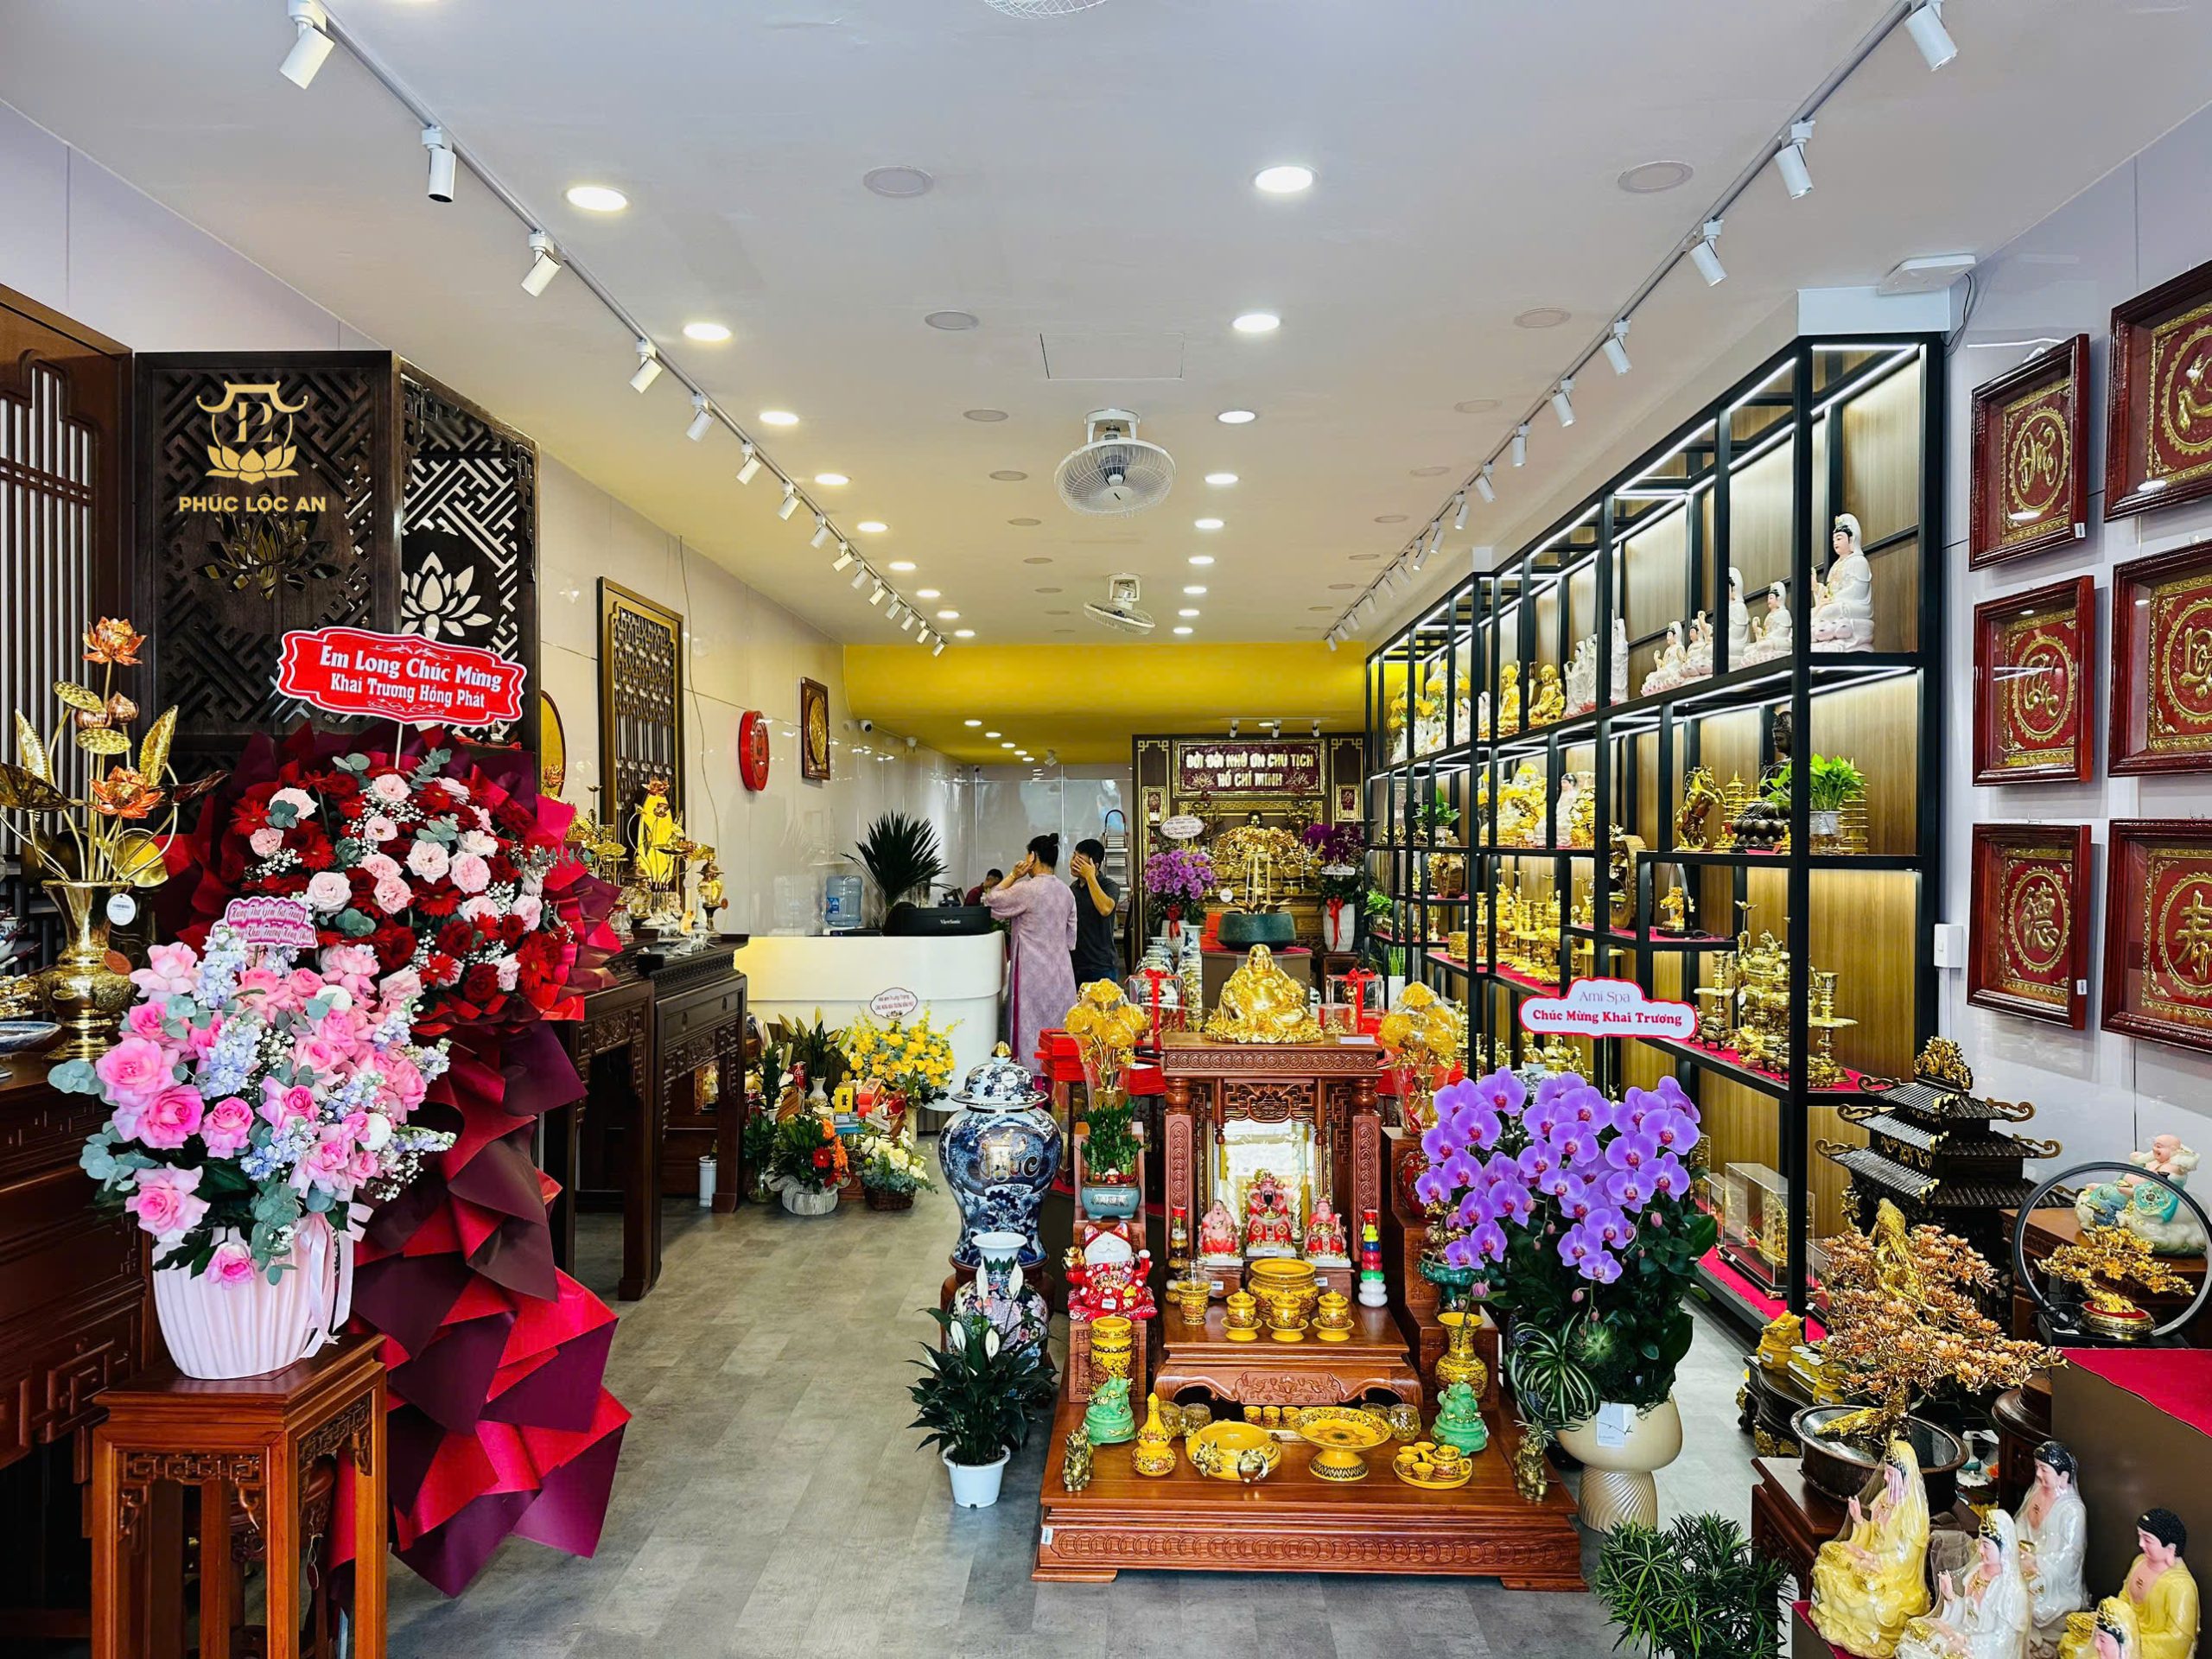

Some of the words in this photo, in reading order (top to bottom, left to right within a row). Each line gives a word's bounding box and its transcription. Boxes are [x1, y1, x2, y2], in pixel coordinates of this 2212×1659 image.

[179, 493, 239, 512] PHÚC
[245, 493, 289, 515] LỘC
[295, 496, 326, 512] AN
[319, 645, 349, 669] Em
[354, 650, 401, 679] Long
[406, 658, 450, 683] Chúc
[454, 664, 503, 692] Mừng
[330, 672, 363, 694] Khai
[366, 679, 416, 703] Trương
[420, 684, 453, 709] Hồng
[456, 690, 486, 709] Phát
[1268, 749, 1287, 768] CHỦ
[1291, 753, 1313, 770] TỊCH
[1234, 770, 1252, 787] CHÍ
[1255, 772, 1283, 787] MINH
[2018, 881, 2060, 953] 德
[1580, 991, 1603, 1002] Ami
[1606, 992, 1630, 1005] Spa
[1533, 1009, 1562, 1020] Chúc
[1566, 1010, 1599, 1024] Mừng
[1602, 1011, 1631, 1023] Khai
[1635, 1013, 1682, 1027] Trương
